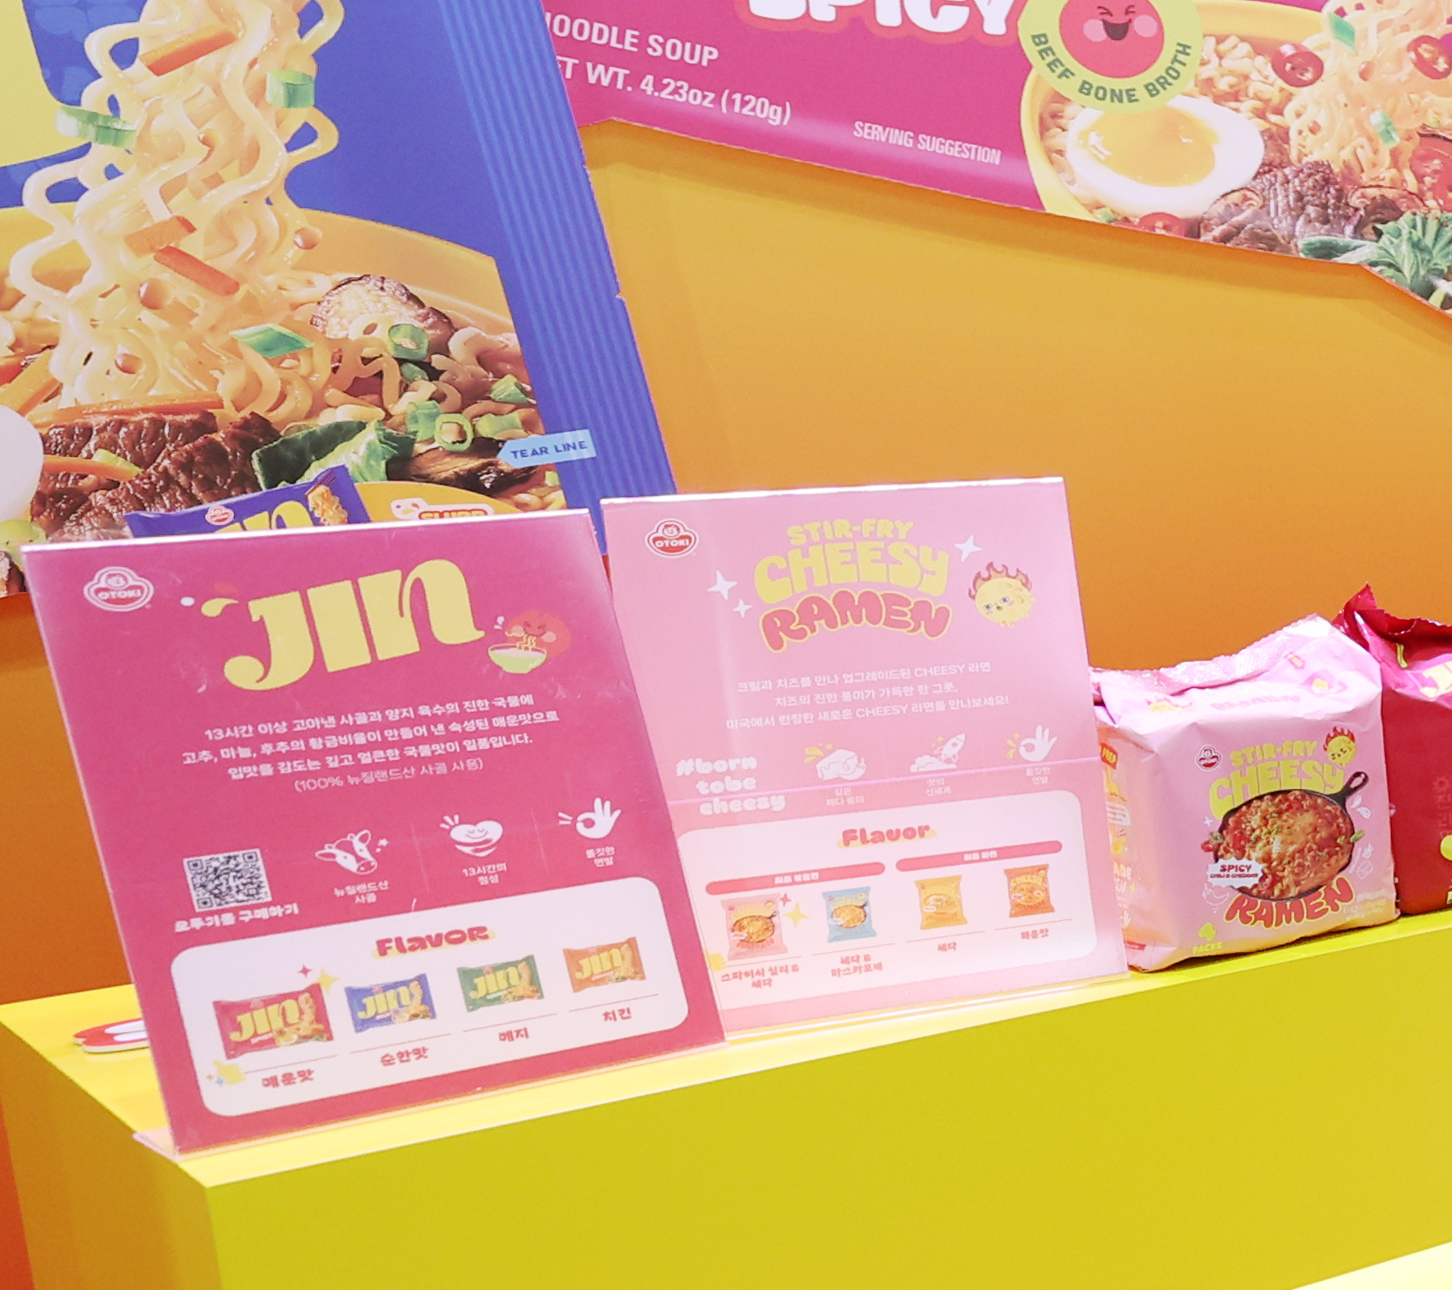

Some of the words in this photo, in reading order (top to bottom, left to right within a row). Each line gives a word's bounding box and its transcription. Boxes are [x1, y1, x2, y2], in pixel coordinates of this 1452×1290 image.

[647, 33, 719, 67] SOUP
[1031, 33, 1076, 80] BEEF
[1078, 80, 1139, 103] BONE
[1144, 42, 1192, 97] BROTH
[586, 62, 632, 92] WT.
[640, 74, 716, 109] 4.23oz
[721, 89, 792, 127] (120g)
[853, 120, 913, 149] SERVING
[918, 131, 1001, 166] SUGGESTION
[510, 445, 549, 459] TEAR
[553, 441, 588, 455] LINE
[654, 536, 690, 549] OTOKI
[787, 518, 914, 546] STIR-FRY
[754, 542, 950, 604] CHEESY
[98, 587, 141, 600] OTOKI
[759, 589, 952, 652] RAMEN
[776, 676, 811, 690] 치즈를
[914, 663, 965, 677] CHEESY
[968, 661, 991, 673] 라면
[204, 724, 254, 741] 13시간
[258, 722, 287, 735] 이상
[339, 711, 382, 727] 사골과
[462, 698, 490, 714] 진한
[492, 693, 534, 709] 국물에
[726, 715, 775, 730] 미국에서
[856, 704, 907, 719] CHEESY
[948, 695, 1009, 710] 만나보세요!
[775, 693, 810, 707] 치즈의
[182, 749, 218, 765] 고추,
[220, 745, 256, 761] 마늘,
[260, 740, 305, 756] 후추의
[492, 710, 560, 728] 매운맛으로
[1230, 740, 1318, 767] STIR-FRY
[228, 763, 274, 780] 입맛을
[403, 741, 460, 760] 국물맛이
[463, 732, 533, 752] 일품입니다.
[295, 776, 343, 793] (100%
[420, 762, 448, 776] 사골
[1209, 760, 1346, 820] CHEESY
[699, 794, 786, 817] cheesy
[1220, 863, 1252, 874] SPICY
[1223, 876, 1355, 928] RAMEN
